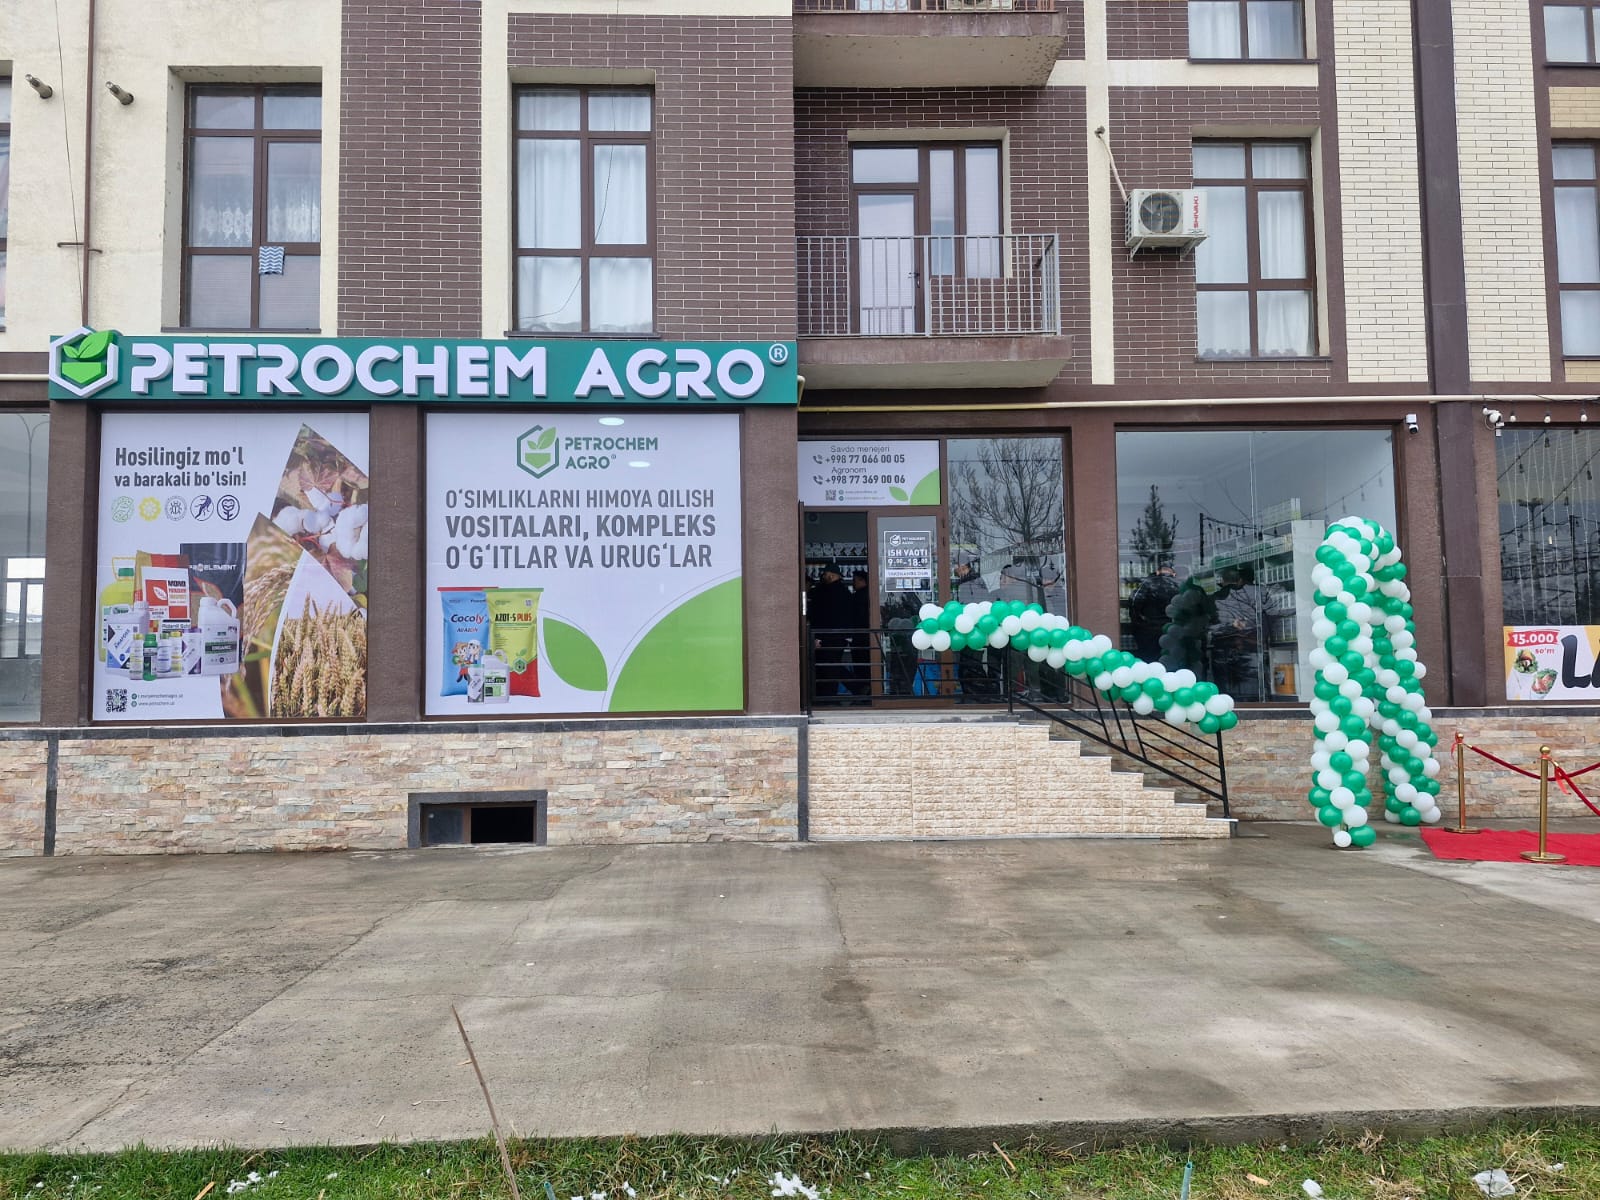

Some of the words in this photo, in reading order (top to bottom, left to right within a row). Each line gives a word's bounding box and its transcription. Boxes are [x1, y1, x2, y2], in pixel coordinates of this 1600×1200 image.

[130, 343, 547, 397] PETROCHEM
[574, 347, 765, 399] AGRO
[565, 437, 658, 451] PETROCHEM
[831, 445, 855, 453] Savdo
[857, 445, 890, 455] menejeri
[115, 447, 200, 470] Hosilingiz
[205, 446, 244, 466] mo'l
[565, 456, 610, 469] AGRO
[825, 454, 847, 464] +998
[849, 454, 860, 464] 77
[862, 454, 879, 464] 066
[881, 454, 891, 464] 00
[894, 454, 905, 464] 05
[831, 466, 867, 475] Agronom
[114, 475, 131, 487] va
[134, 471, 191, 487] barakali
[194, 471, 247, 487] bo'lsin!
[825, 475, 847, 485] +998
[849, 475, 860, 484] 77
[862, 475, 879, 484] 369
[881, 475, 892, 484] 00
[894, 475, 906, 484] 06
[586, 489, 652, 508] HIMOYA
[658, 489, 715, 509] QILISH
[446, 514, 590, 541] VOSITALARI,
[596, 514, 716, 538] KOMPLEKS
[566, 545, 593, 568] VA
[888, 549, 902, 557] ISH
[451, 613, 485, 625] Cocoly
[1512, 633, 1555, 645] 15.000
[1535, 647, 1555, 655] so'm
